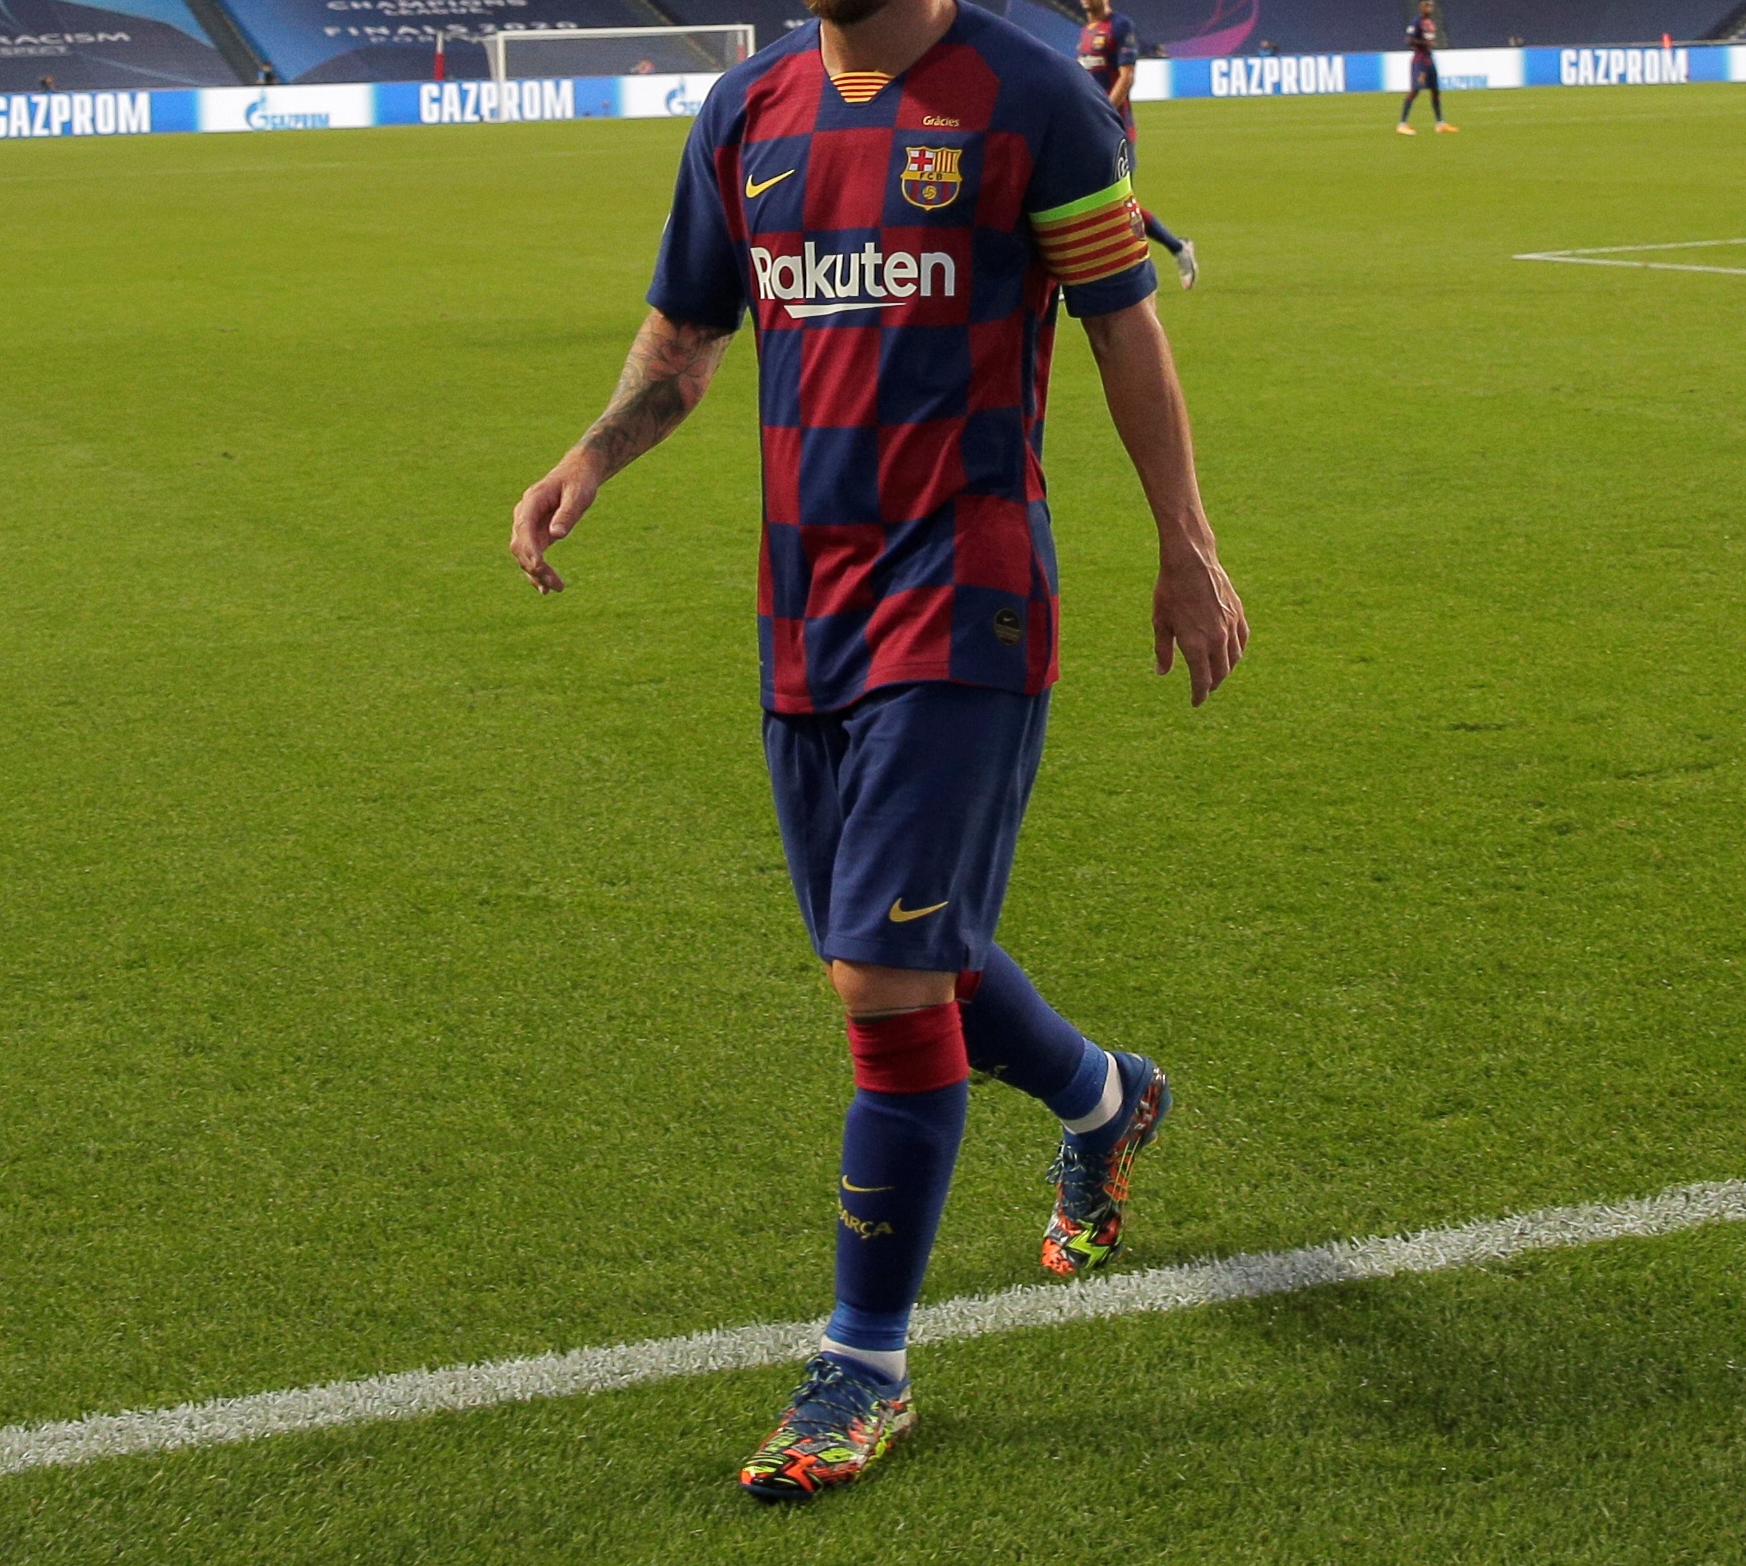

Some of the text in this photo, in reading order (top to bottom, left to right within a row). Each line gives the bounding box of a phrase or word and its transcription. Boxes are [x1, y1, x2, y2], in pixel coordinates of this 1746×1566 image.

[1210, 55, 1346, 97] GAZPROM
[1559, 48, 1690, 86] GAZPROM
[418, 79, 574, 124] GAZPROM
[749, 241, 956, 300] Rakuten
[838, 1197, 894, 1240] ARÇA
